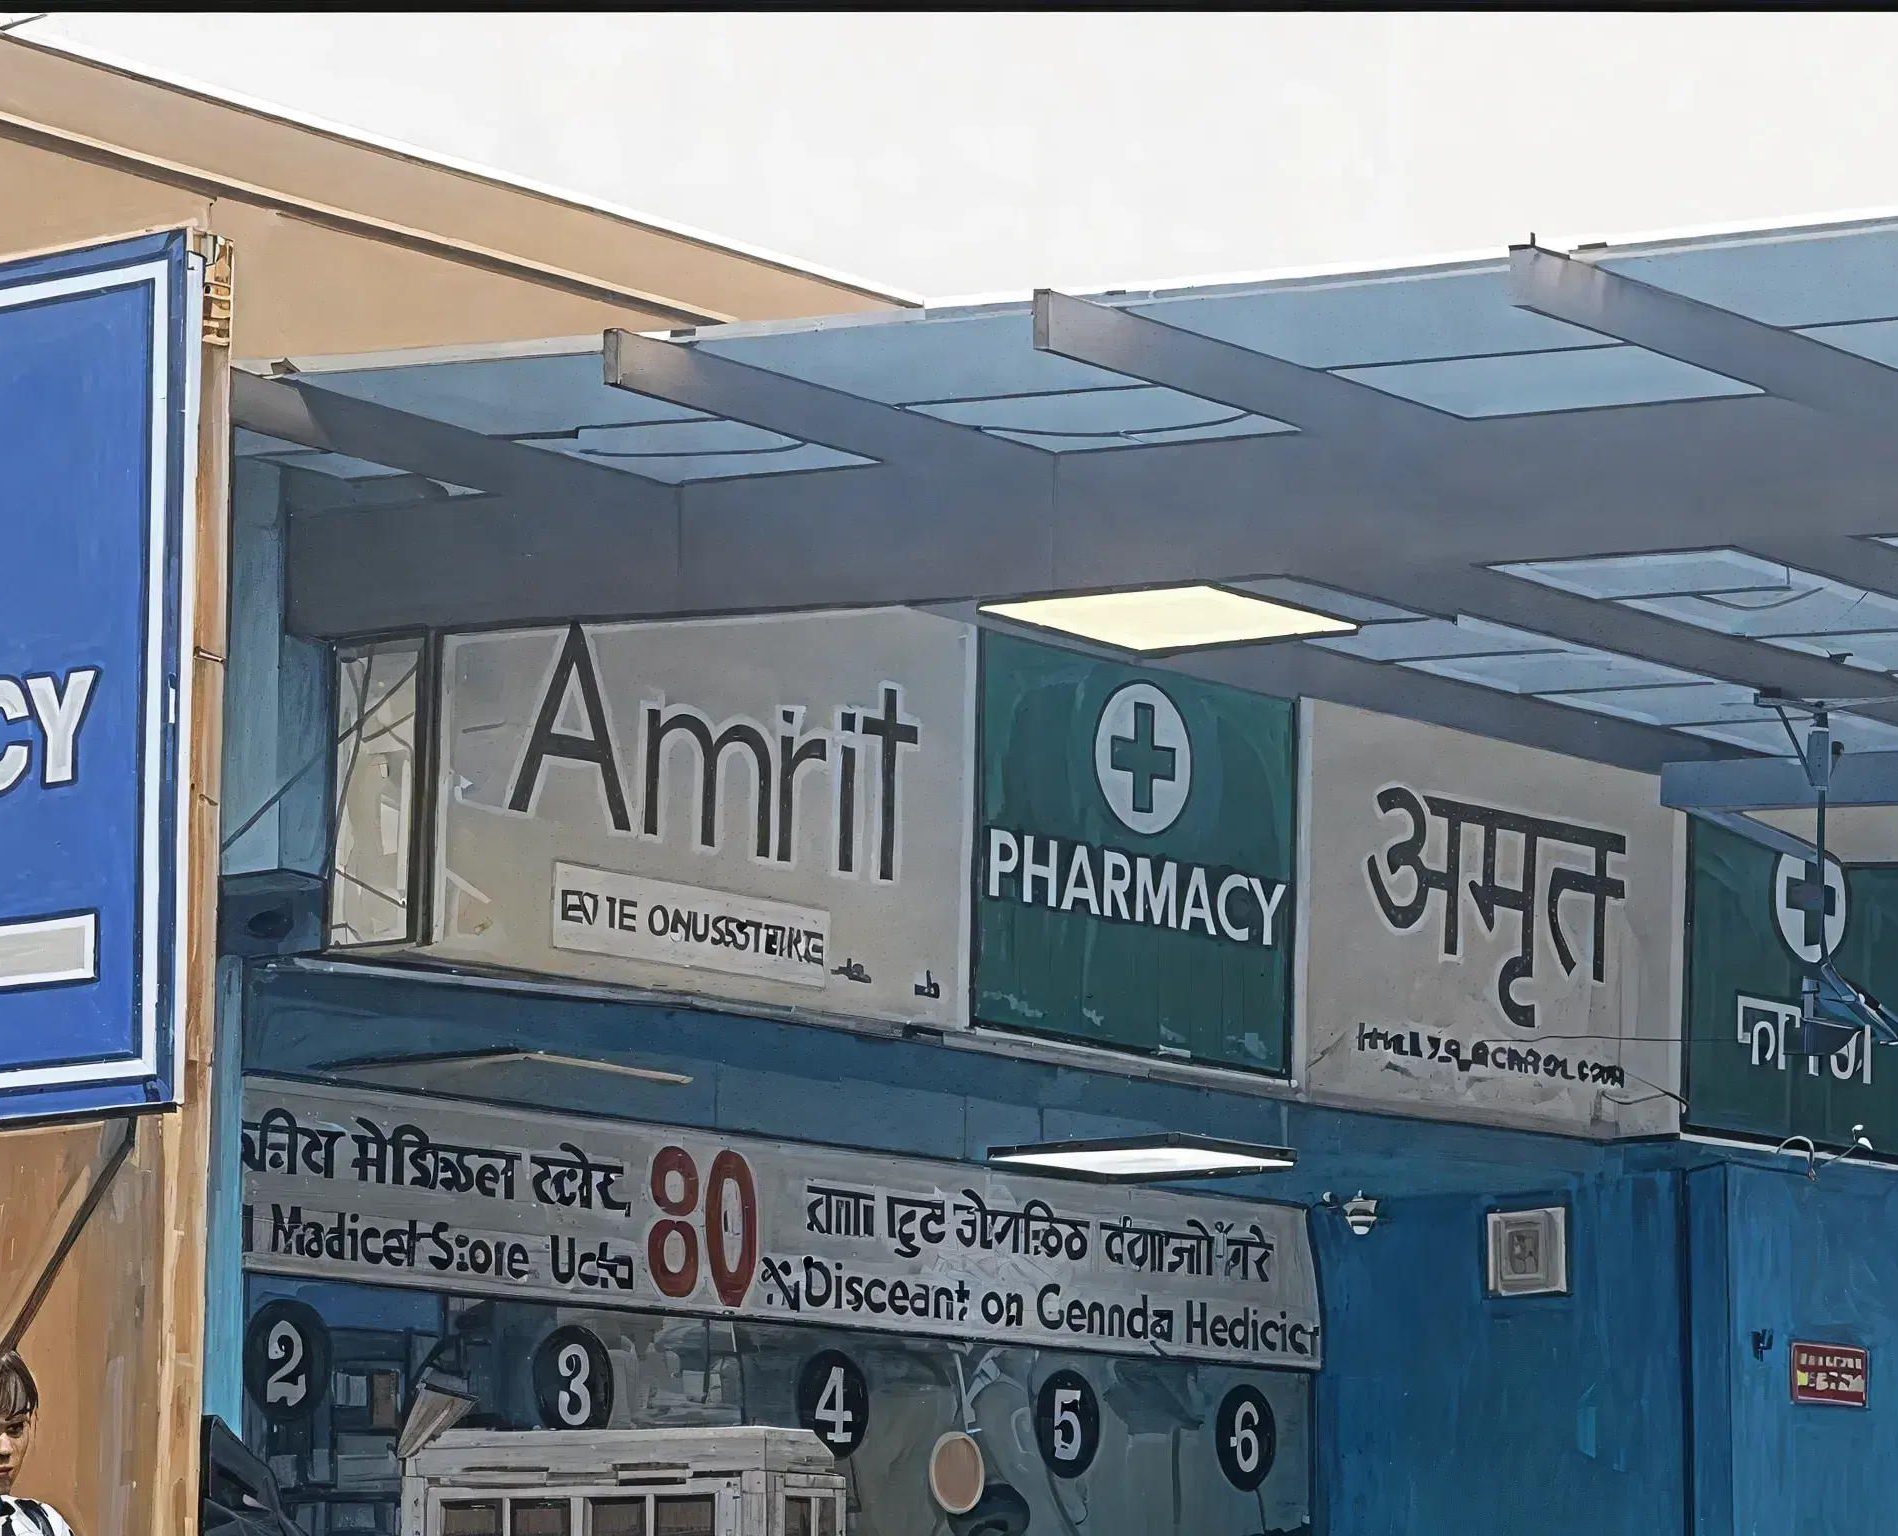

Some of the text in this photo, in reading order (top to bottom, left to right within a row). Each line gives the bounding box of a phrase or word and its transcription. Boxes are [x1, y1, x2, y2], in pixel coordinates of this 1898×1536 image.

[508, 621, 919, 881] Amrit
[988, 829, 1287, 947] PHARMACY
[1367, 786, 1626, 1028] अमृत
[647, 1145, 757, 1308] 80
[981, 1290, 1023, 1328] on
[267, 1320, 307, 1407] 2
[557, 1343, 591, 1426] 3
[815, 1365, 853, 1443] 4
[1053, 1389, 1082, 1462] 5
[1231, 1401, 1260, 1473] 6
